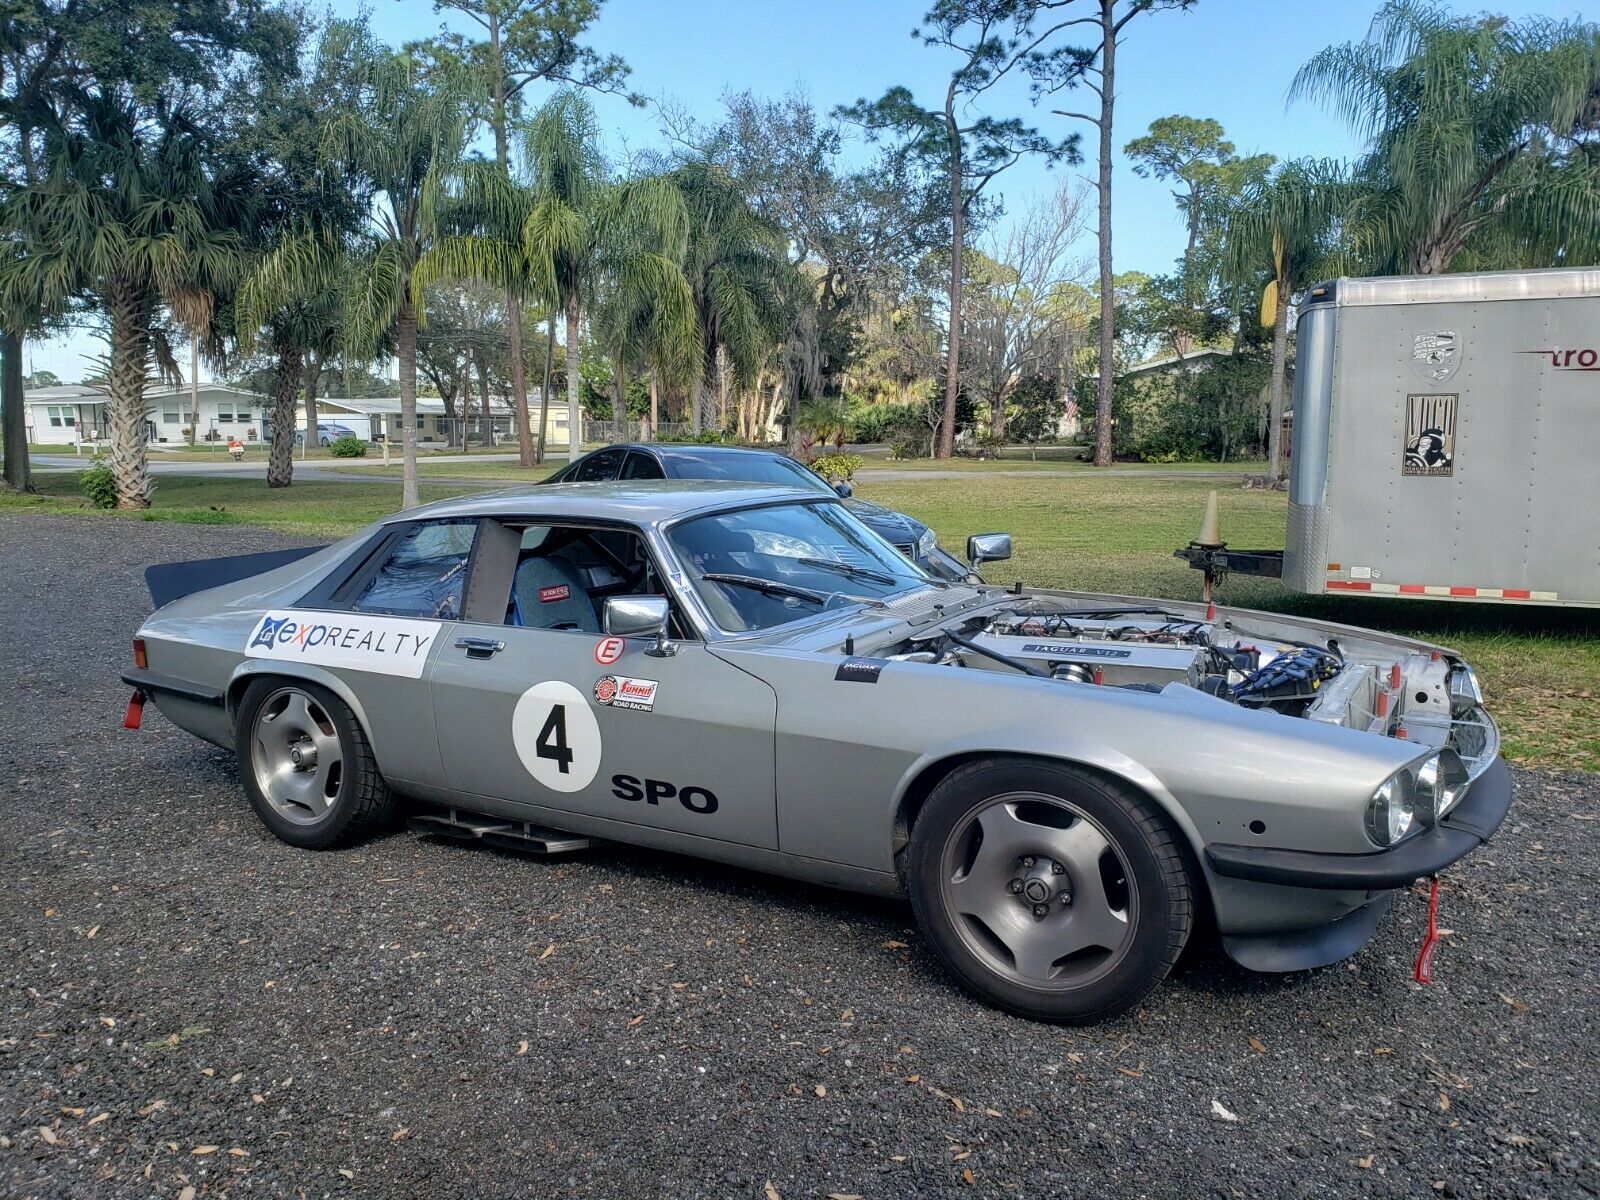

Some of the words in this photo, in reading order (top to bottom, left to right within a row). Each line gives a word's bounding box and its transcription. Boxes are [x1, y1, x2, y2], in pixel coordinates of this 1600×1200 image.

[601, 640, 619, 658] E
[1034, 645, 1087, 654] JAGUAR
[620, 679, 656, 697] SUMMIT
[612, 700, 630, 708] ROAD
[630, 703, 652, 711] RACING
[536, 704, 573, 774] 4
[611, 774, 719, 814] SPO
